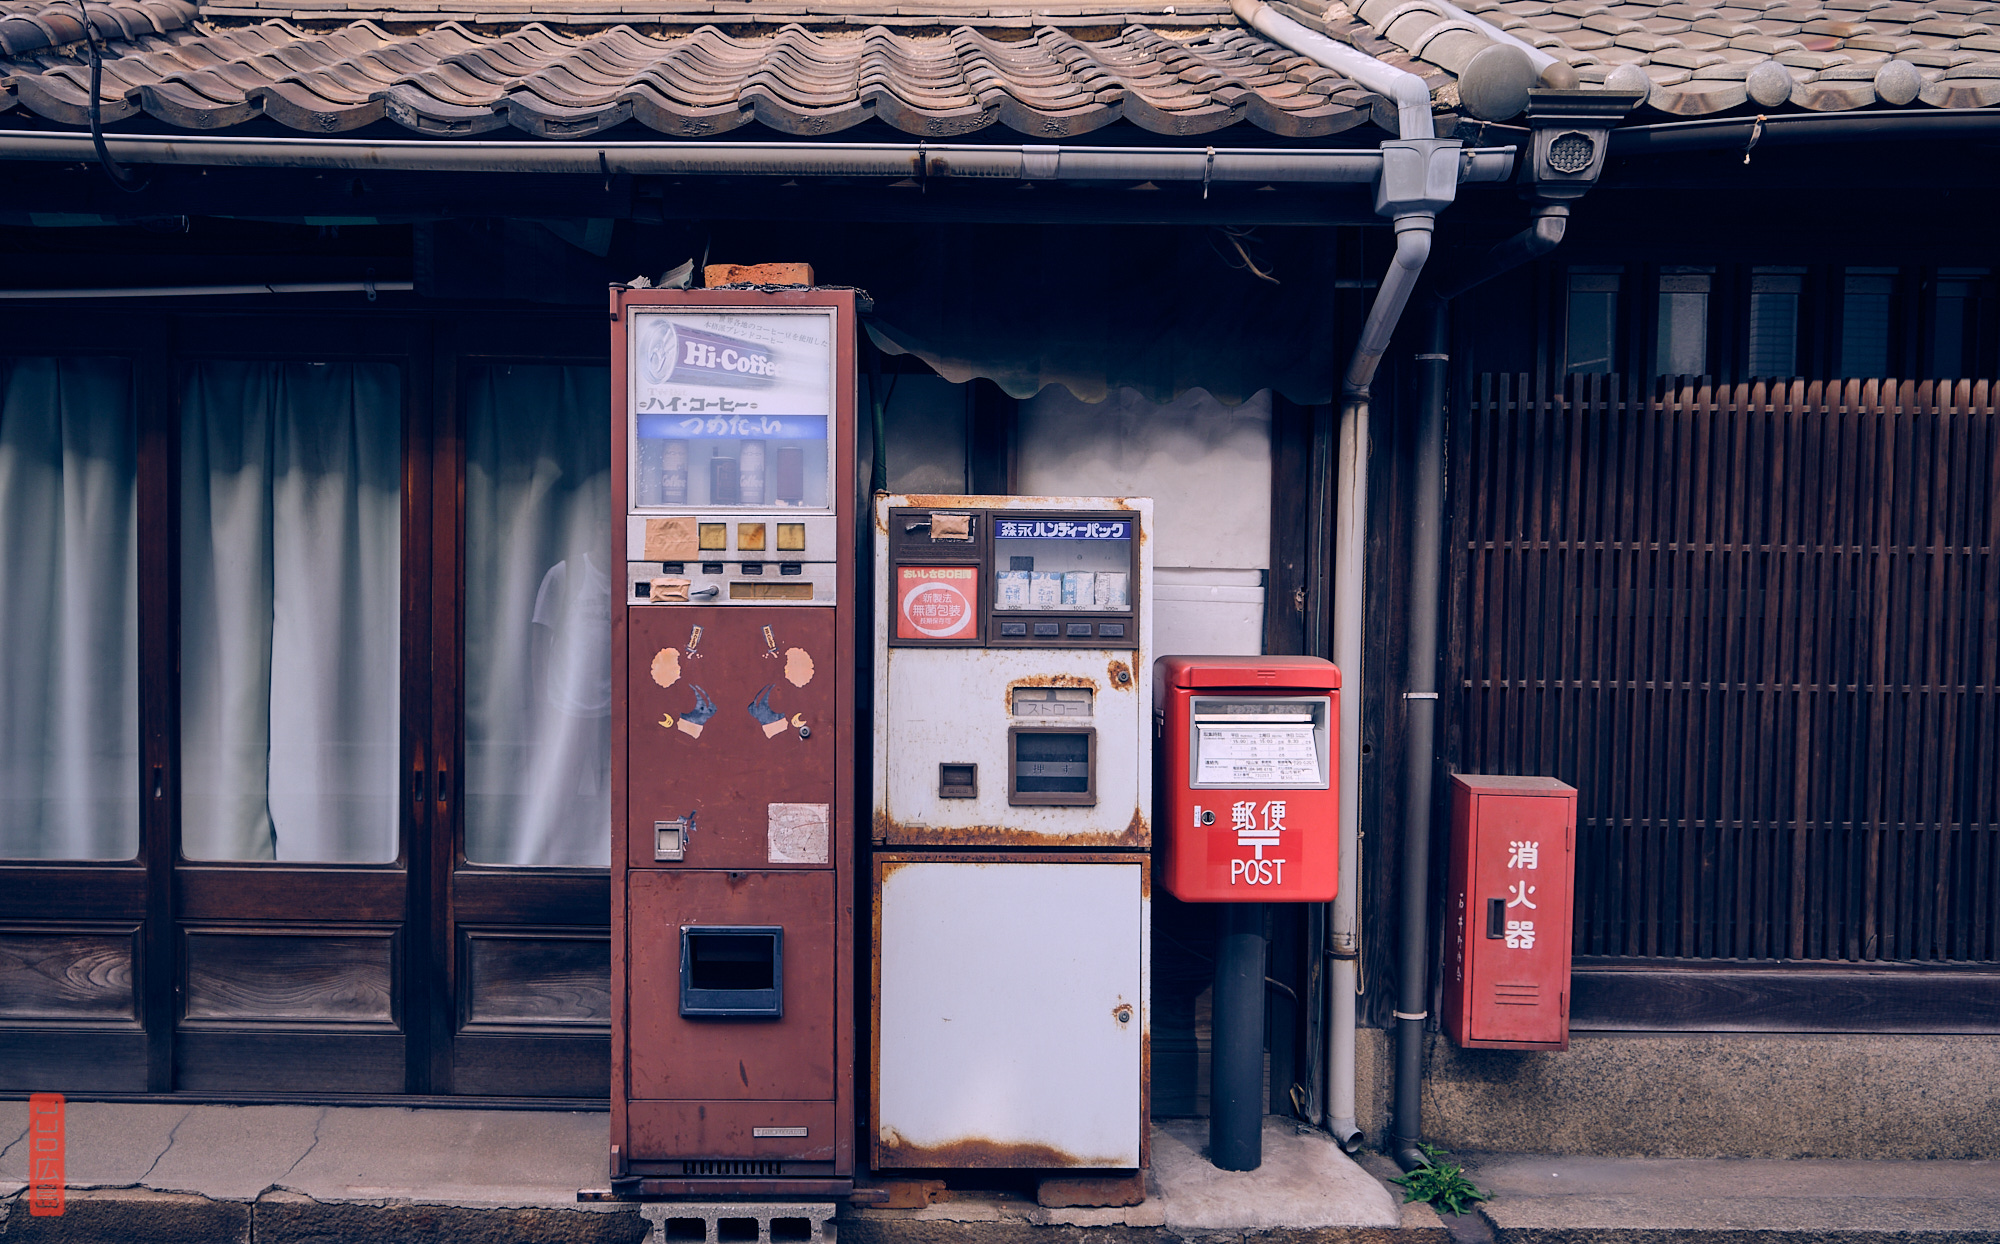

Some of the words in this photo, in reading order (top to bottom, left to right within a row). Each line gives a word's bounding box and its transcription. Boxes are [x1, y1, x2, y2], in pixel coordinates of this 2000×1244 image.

[1001, 522, 1124, 538] 森永ハンディーパック
[912, 604, 961, 617] 無菌包装
[1028, 703, 1078, 715] ストロー
[1231, 800, 1287, 831] 郵便
[1231, 859, 1286, 885] POST
[1505, 840, 1539, 950] 消火器
